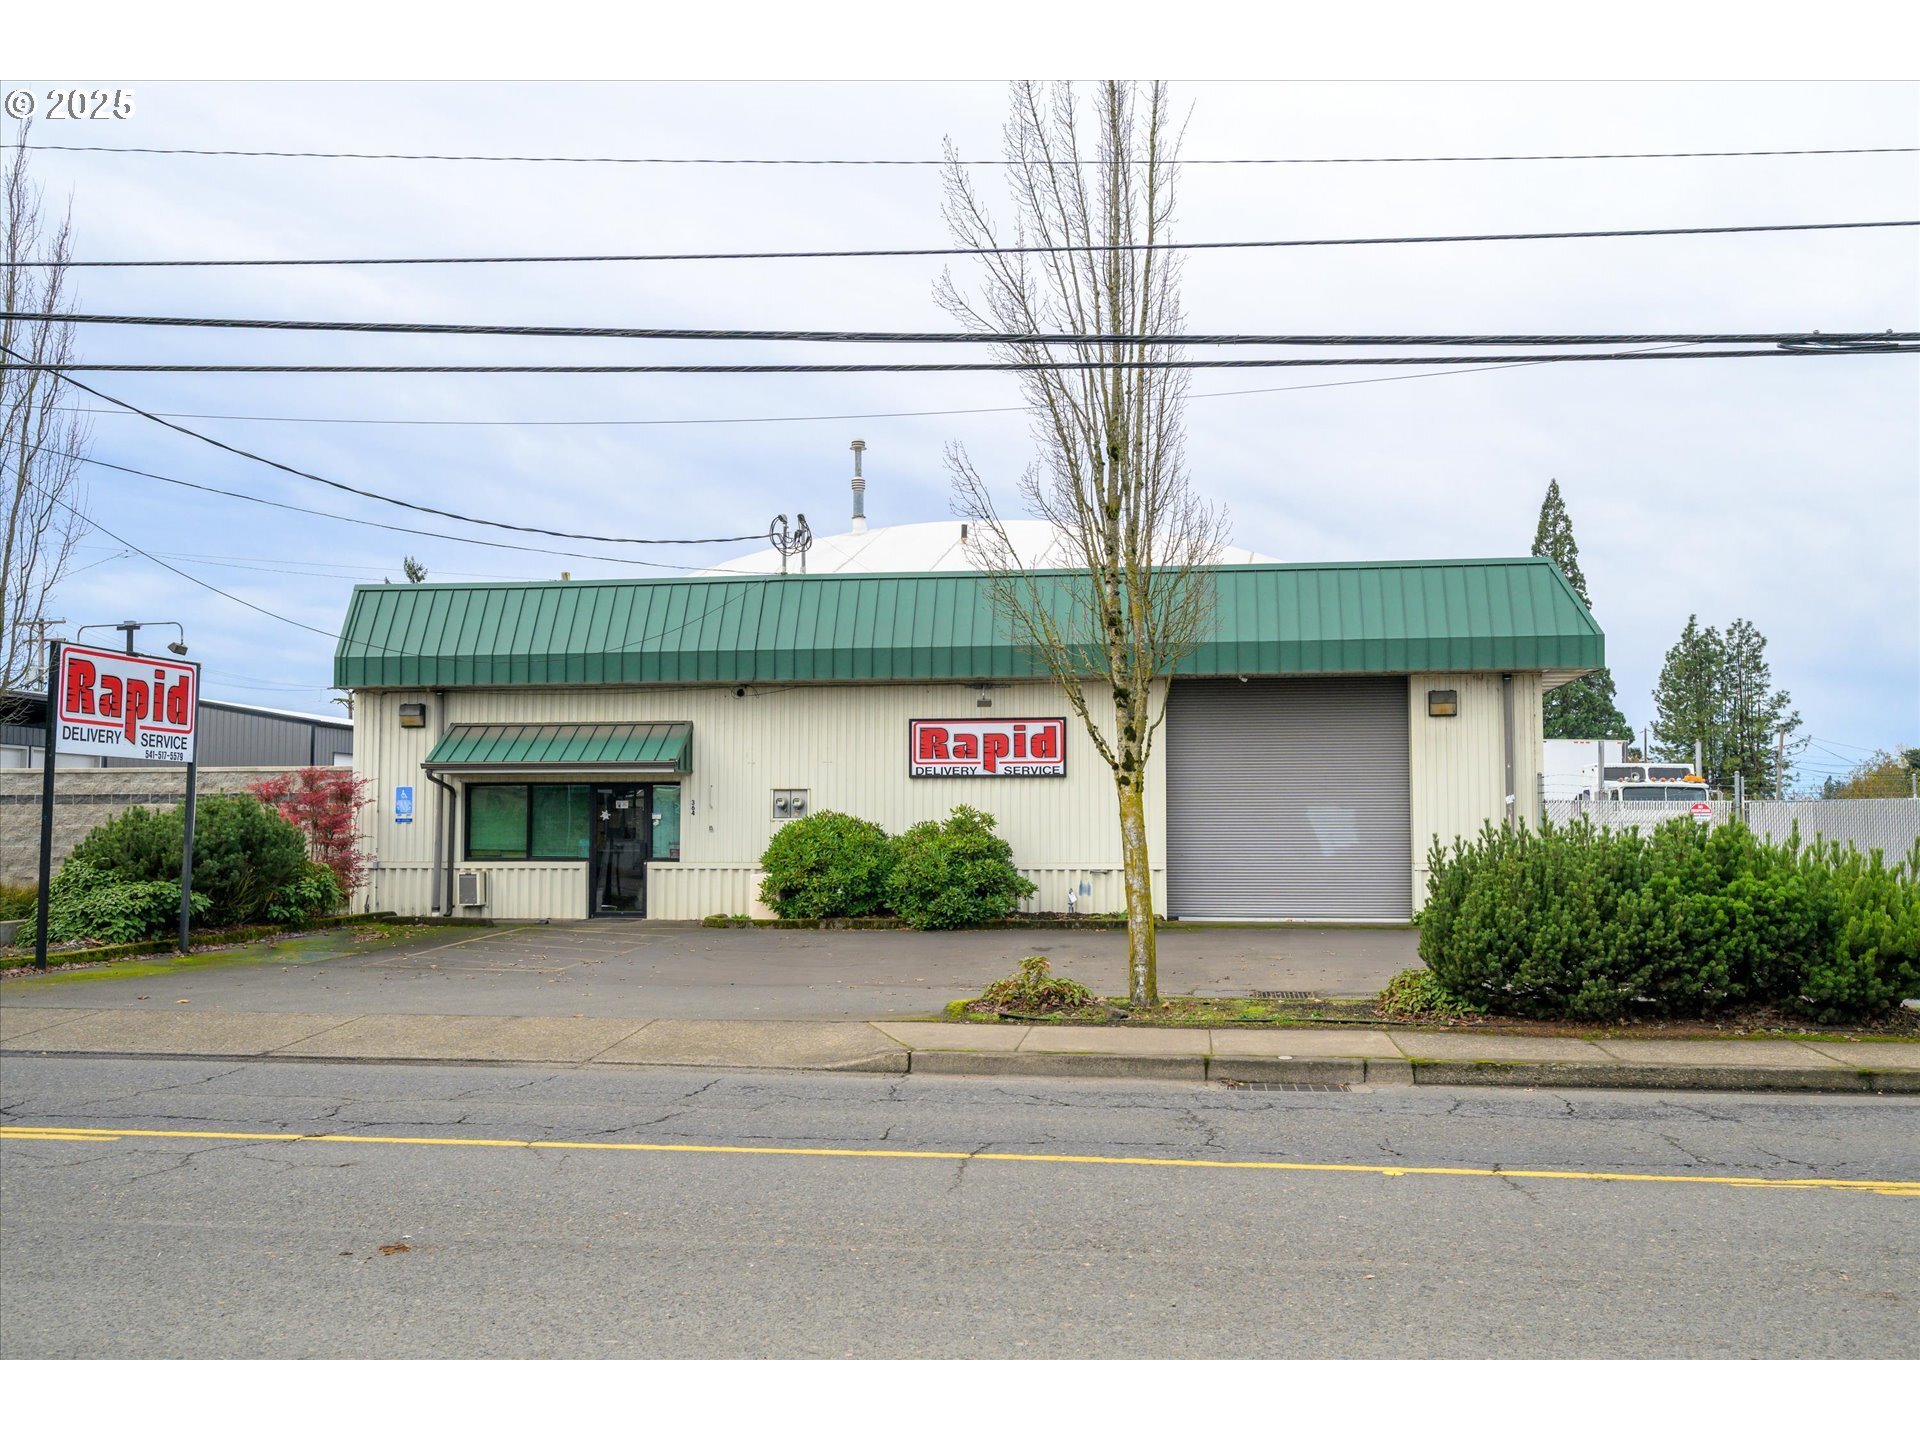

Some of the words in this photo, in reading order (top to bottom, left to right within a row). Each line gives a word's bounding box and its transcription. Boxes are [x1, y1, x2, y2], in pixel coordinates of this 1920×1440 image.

[65, 657, 190, 745] Rapid
[62, 725, 122, 745] DELIVERY
[140, 733, 188, 750] SERVICE
[919, 724, 1057, 773] Rapid
[145, 750, 184, 761] 541-517-5579
[915, 766, 978, 776] DELIVERY
[1003, 765, 1060, 775] SERVICE
